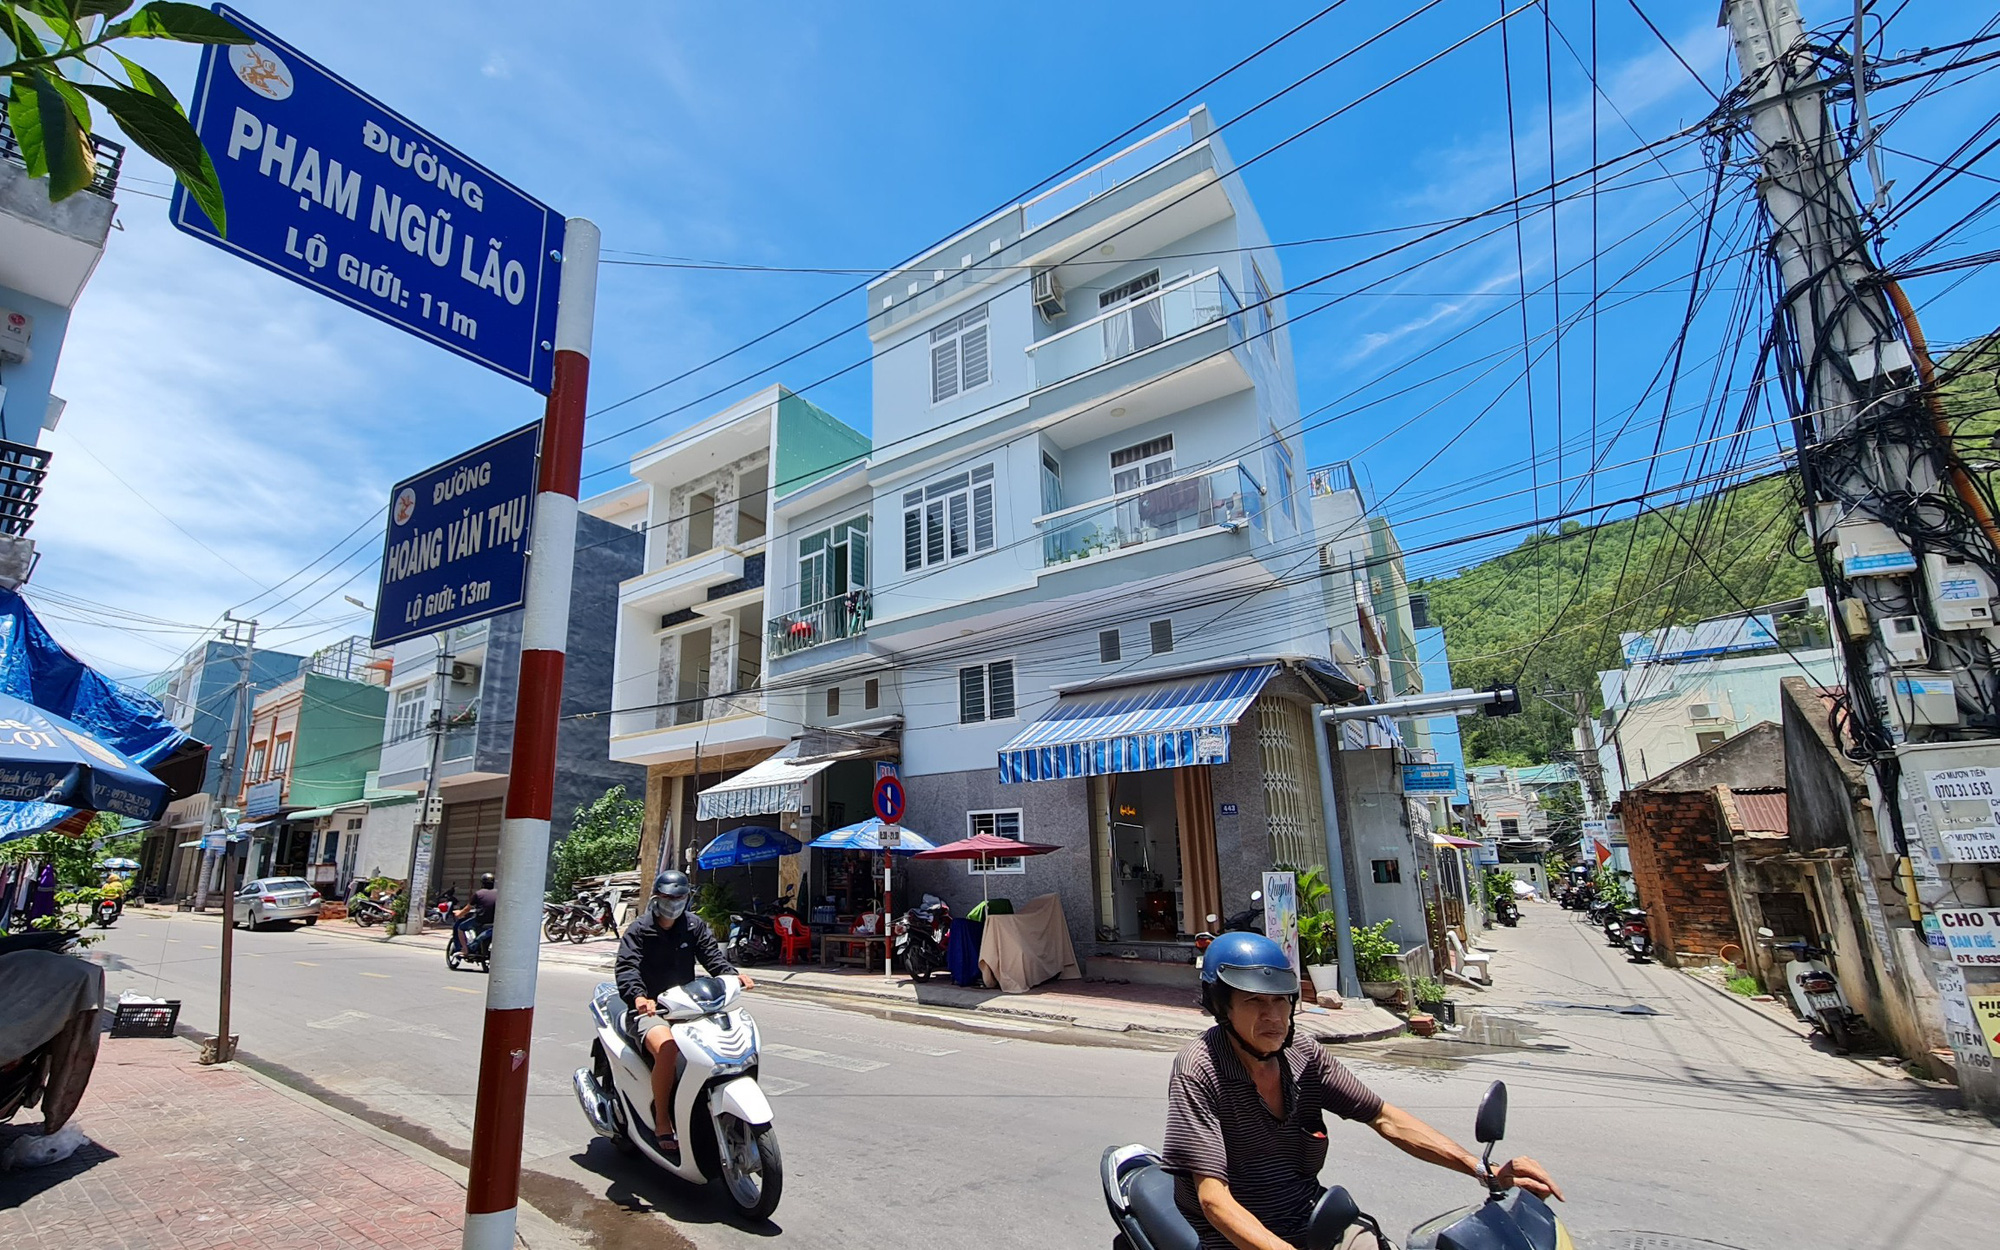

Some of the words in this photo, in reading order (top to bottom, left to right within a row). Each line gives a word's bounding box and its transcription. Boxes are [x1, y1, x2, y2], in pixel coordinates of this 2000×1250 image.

[363, 120, 484, 212] ĐƯỜNG
[227, 107, 362, 221] PHẠM
[370, 185, 453, 267] NGŨ
[461, 234, 526, 306] LÃO
[285, 226, 328, 272] LỘ
[338, 253, 409, 309] GIỚI:
[420, 292, 477, 341] 11m
[8, 325, 21, 334] LG
[433, 462, 491, 505] ĐƯỜNG
[386, 528, 443, 585] HOÀNG
[448, 507, 484, 563] VĂN
[488, 495, 527, 552] THỤ
[405, 594, 422, 627] LỘ
[424, 585, 456, 618] GIỚI:
[460, 580, 491, 607] 13m
[1934, 784, 1957, 798] 0702
[1956, 783, 1968, 797] 31
[1969, 782, 1980, 796] 15
[1980, 781, 1993, 795] 83
[1964, 846, 1977, 860] 31
[1978, 845, 1989, 860] 15
[1941, 912, 1984, 927] CHO
[1948, 932, 1973, 948] BÀN
